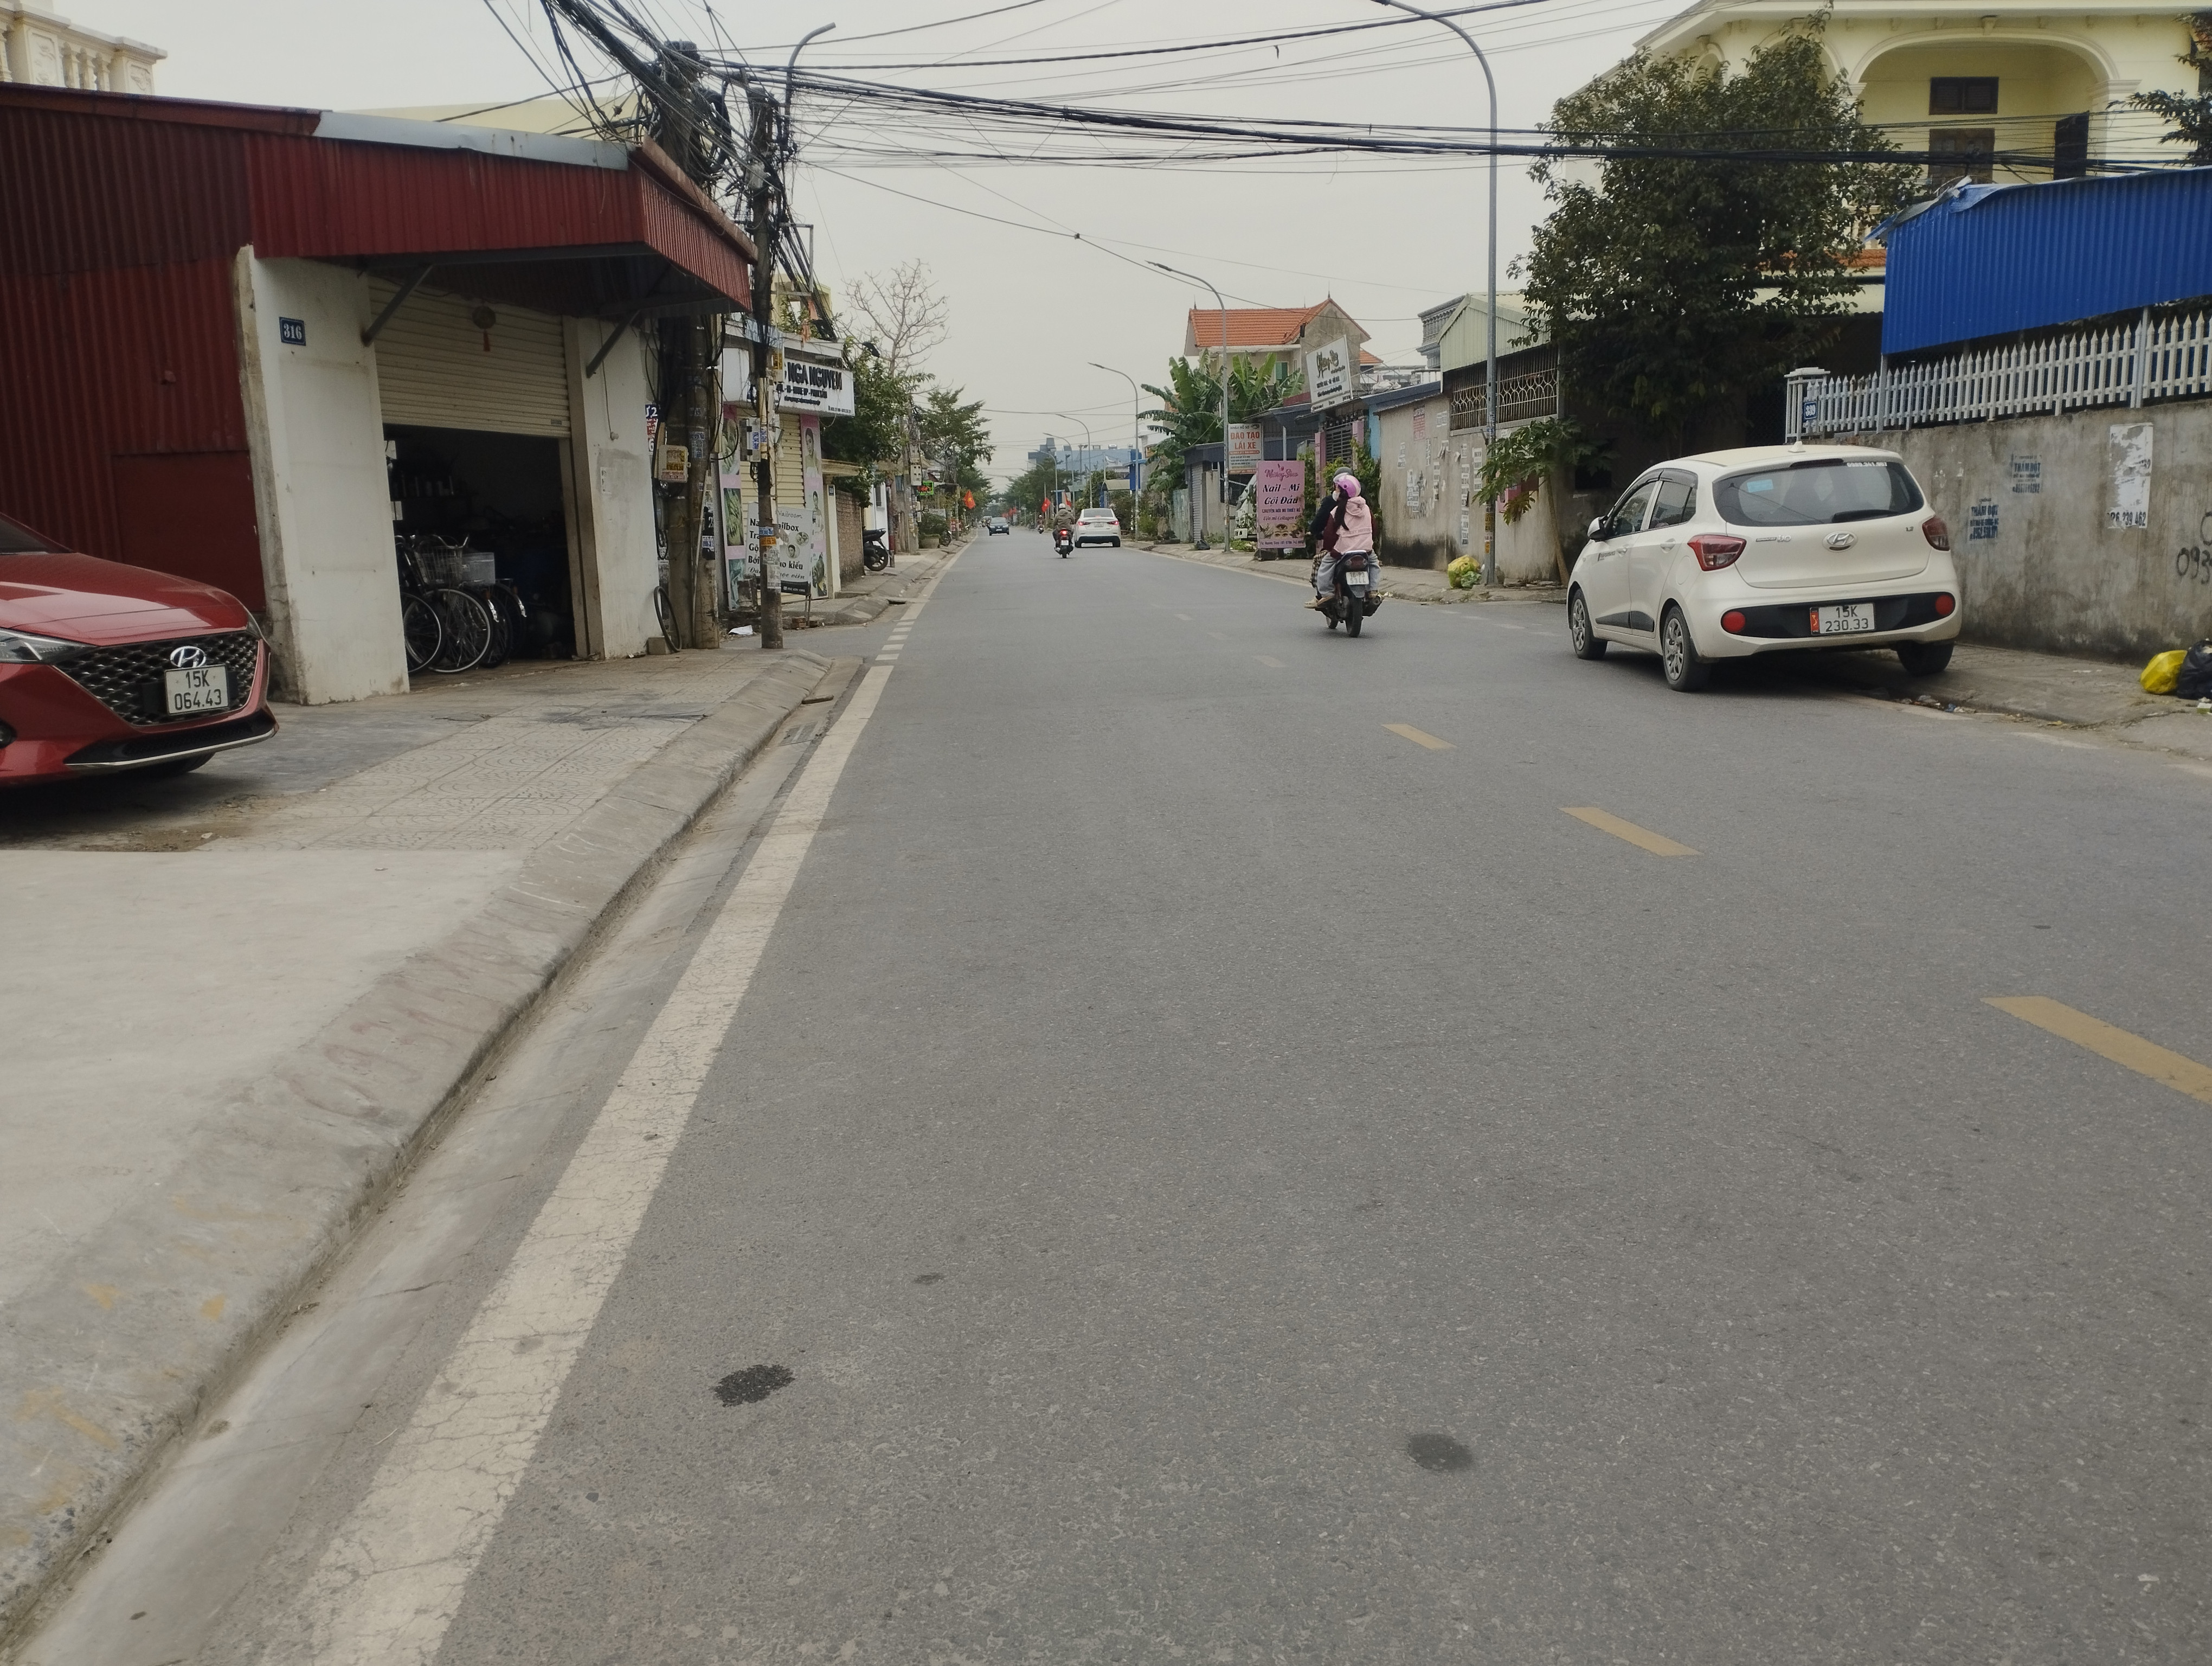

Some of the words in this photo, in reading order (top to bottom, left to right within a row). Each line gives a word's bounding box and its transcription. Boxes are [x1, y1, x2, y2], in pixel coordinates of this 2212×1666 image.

[284, 323, 302, 339] 316
[787, 362, 808, 385] NGA
[1234, 440, 1245, 450] LÁI
[1247, 441, 1256, 450] XE
[1262, 484, 1281, 493] Nail
[1288, 483, 1300, 492] Mi
[1264, 496, 1278, 507] Gội
[778, 522, 799, 531] ailbox
[1777, 534, 1791, 542] i10
[788, 560, 803, 570] kiểu
[2176, 546, 2212, 585] 093
[1835, 606, 1858, 618] 15K
[1825, 618, 1869, 632] 230.33
[185, 669, 210, 689] 15K
[174, 689, 222, 710] 064.43
